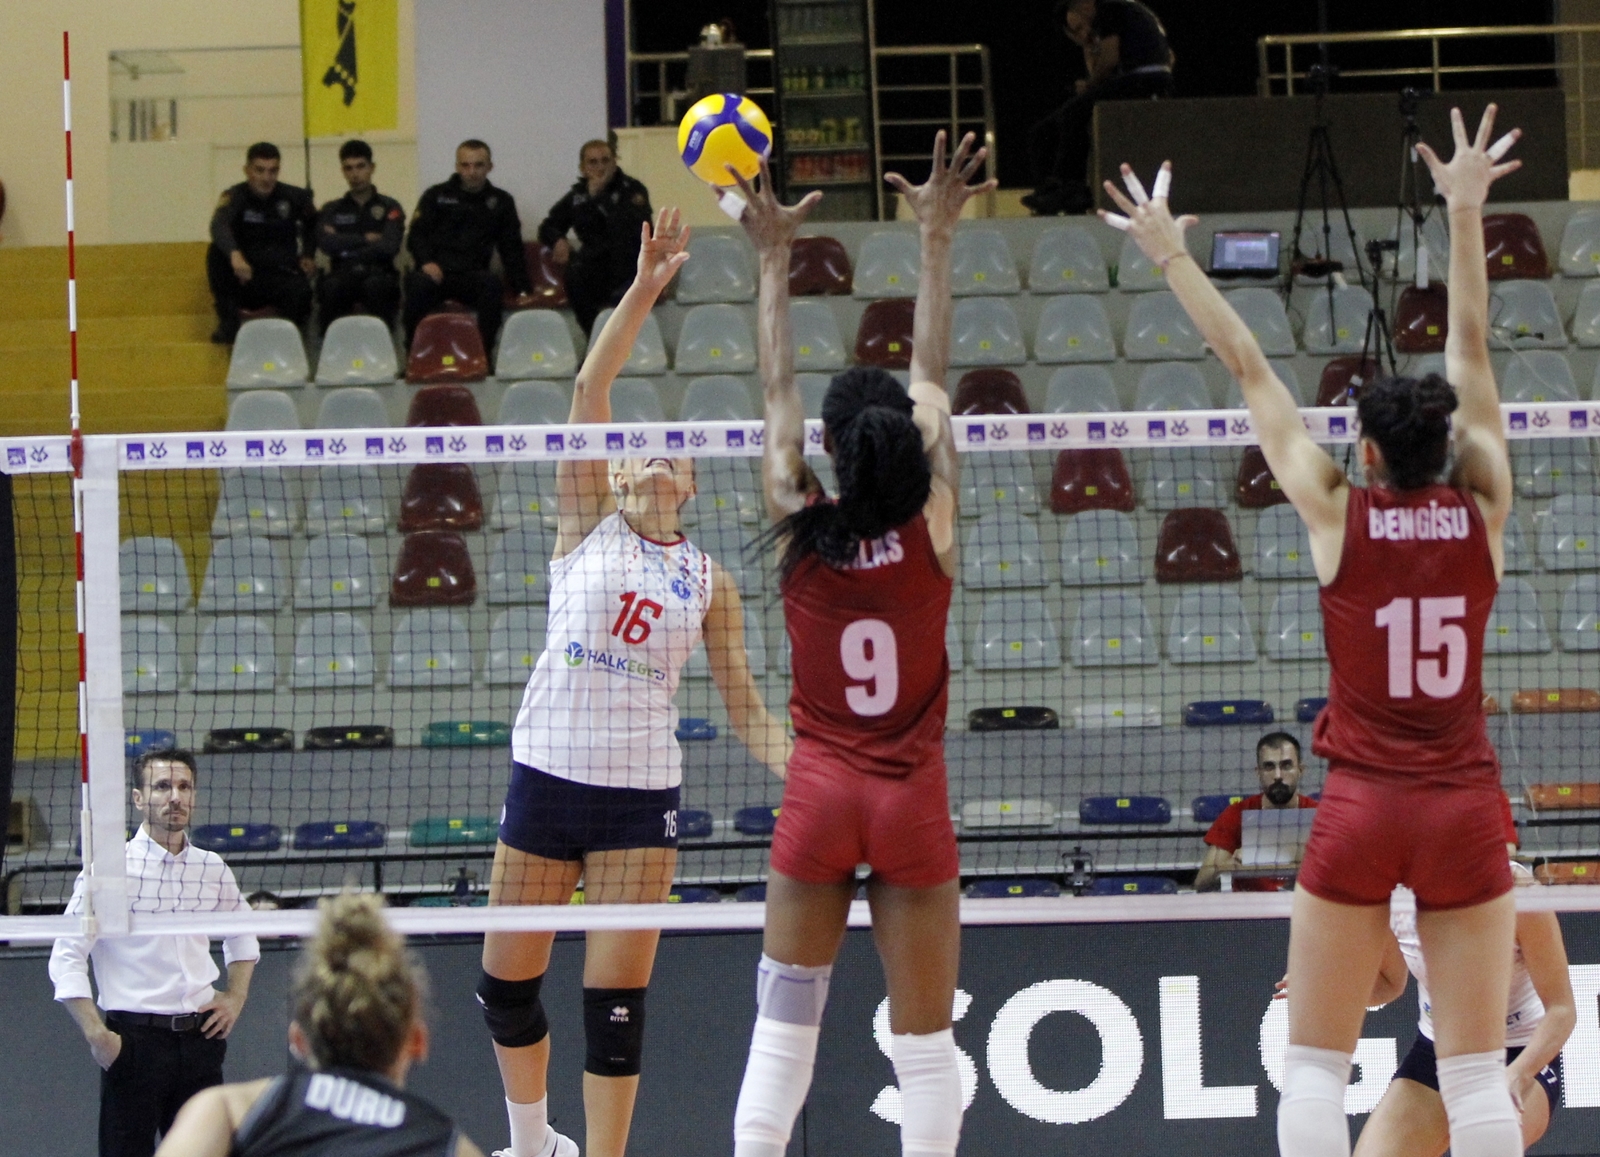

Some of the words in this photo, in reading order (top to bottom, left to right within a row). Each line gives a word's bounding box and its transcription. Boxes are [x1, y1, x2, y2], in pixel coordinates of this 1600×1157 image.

[1368, 499, 1470, 541] BENGİSU
[838, 529, 905, 570] LAS
[611, 591, 664, 645] 16
[840, 618, 899, 717] 9
[1375, 596, 1468, 698] 15
[663, 810, 677, 838] 16
[305, 1072, 406, 1129] DURU
